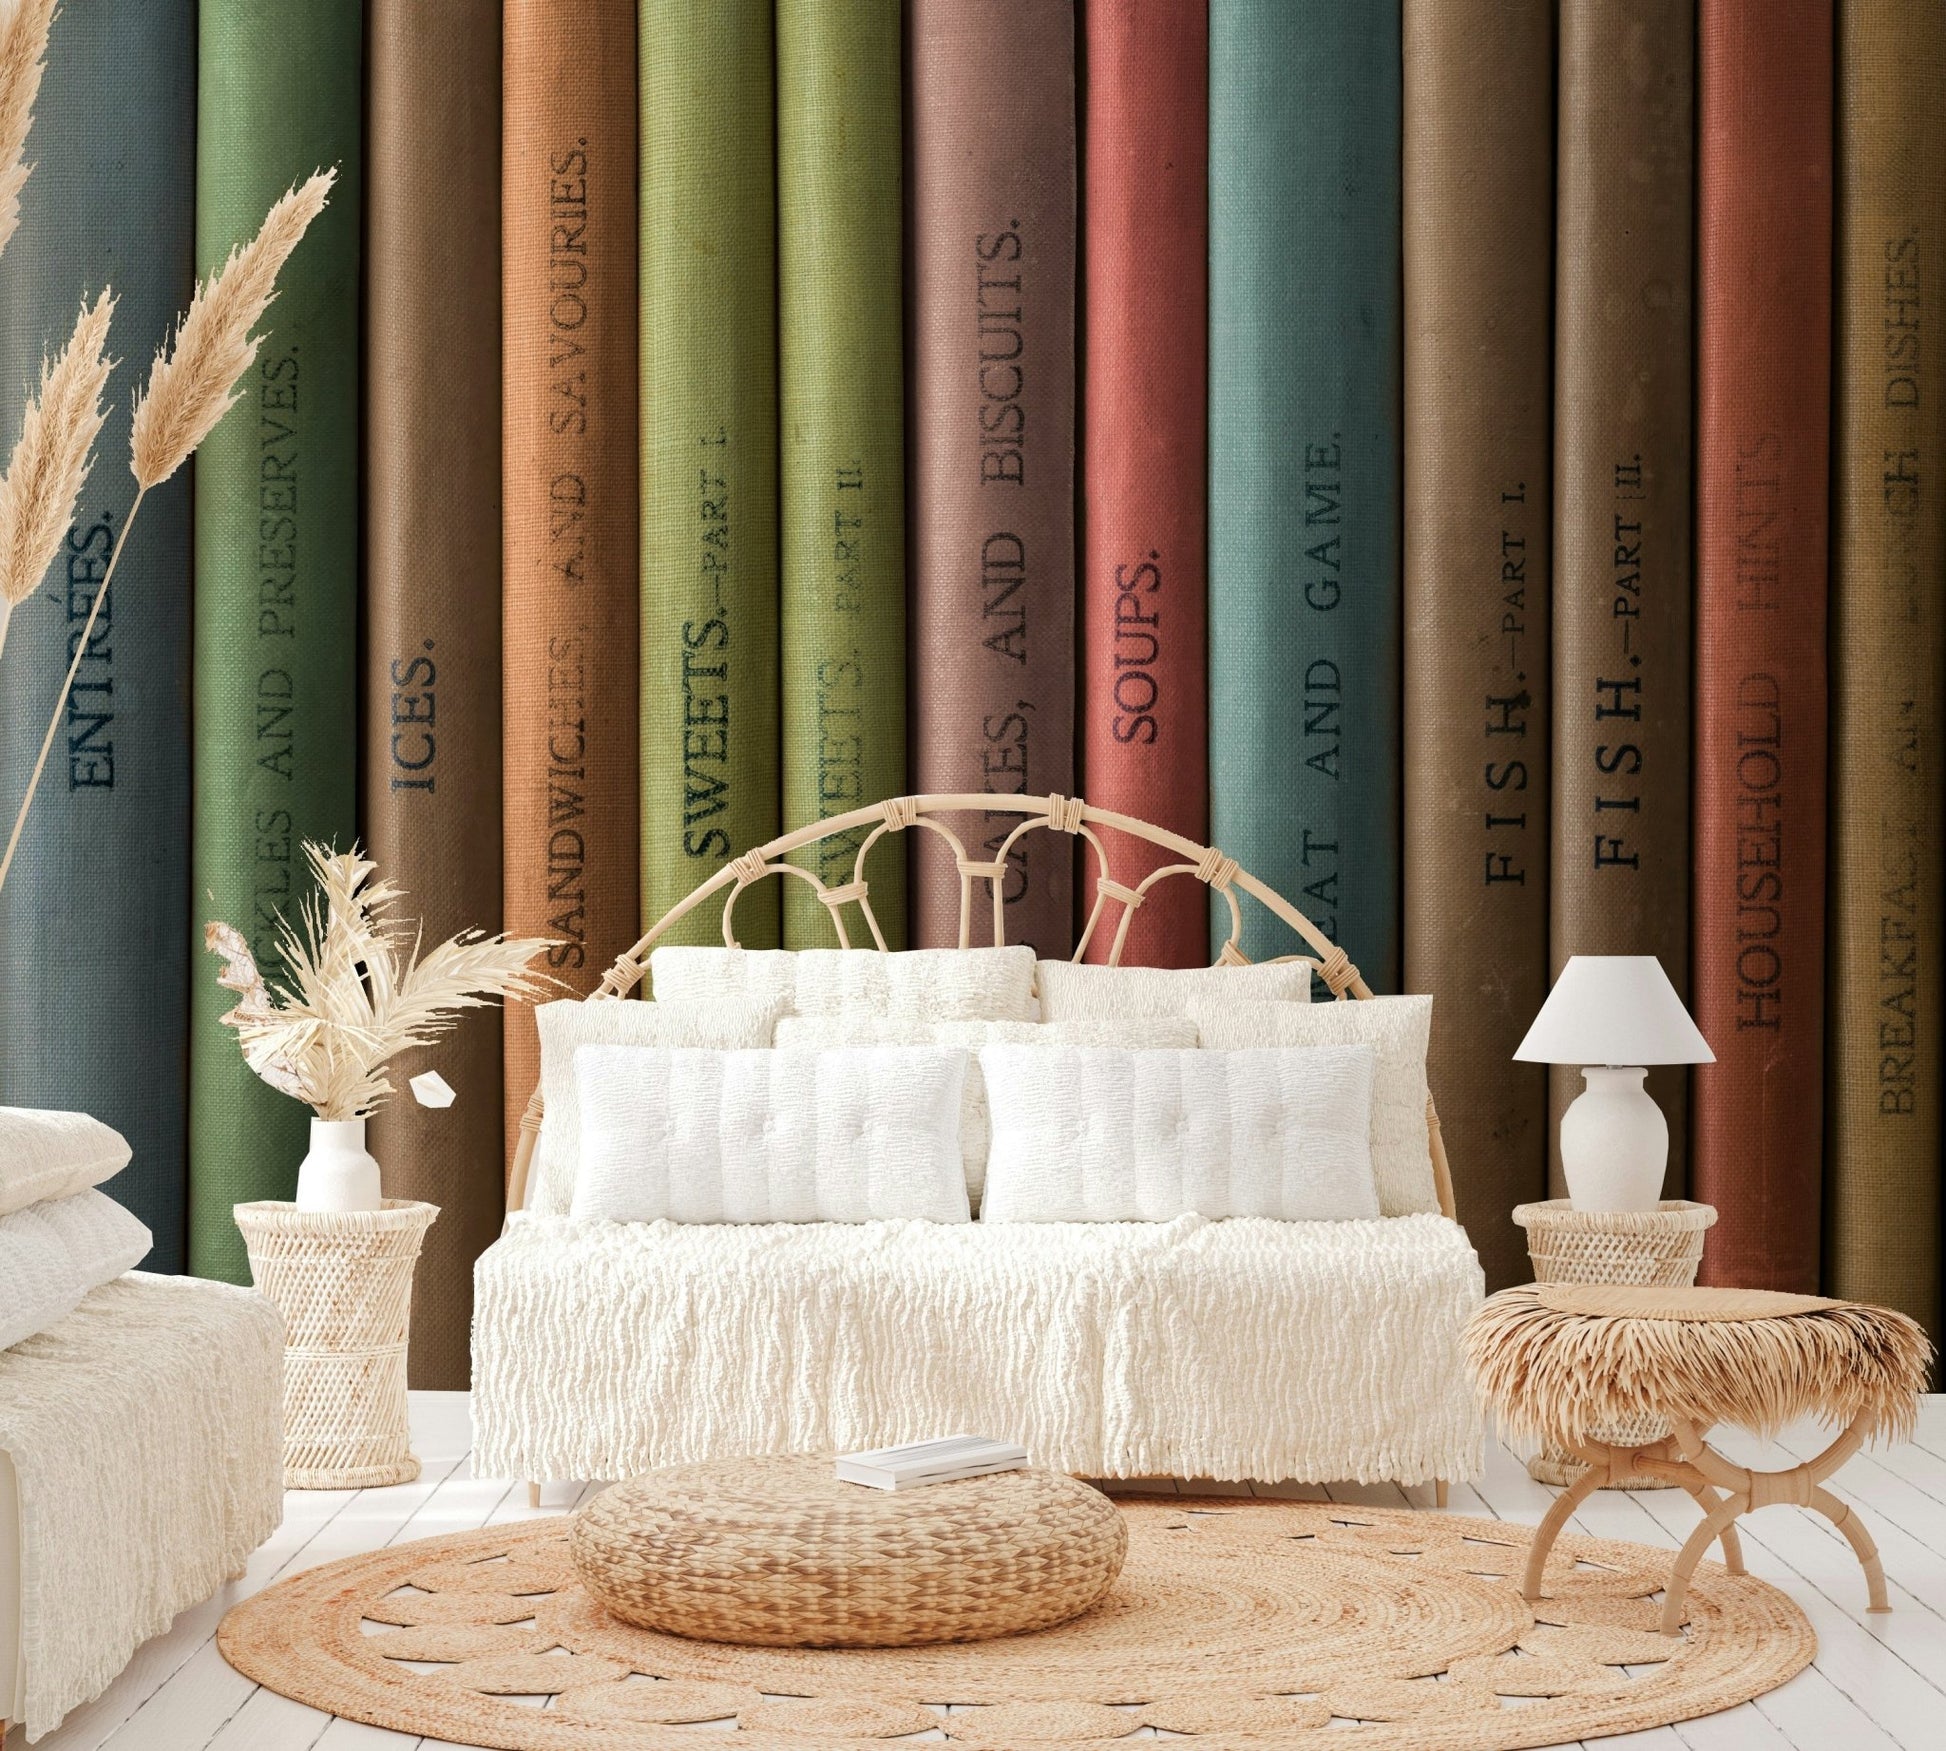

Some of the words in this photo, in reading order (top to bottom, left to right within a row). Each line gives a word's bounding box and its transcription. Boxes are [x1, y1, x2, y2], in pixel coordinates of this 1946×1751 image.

[546, 135, 589, 434] SAVOURIES.
[974, 217, 1025, 486] BISCUITS.
[1883, 222, 1921, 409] DISHES.
[258, 343, 301, 638] PRESERVES.
[547, 472, 587, 582] AND
[1303, 430, 1343, 612] GAME.
[49, 510, 115, 793] ENTRÉES.
[982, 530, 1028, 663] AND
[1111, 550, 1162, 744] SOUPS.
[256, 668, 297, 781] AND
[390, 637, 437, 794] ICES.
[1303, 657, 1342, 780] AND
[1734, 670, 1784, 1032] HOUSEHOLD
[1877, 813, 1918, 1117] BREAKFAST
